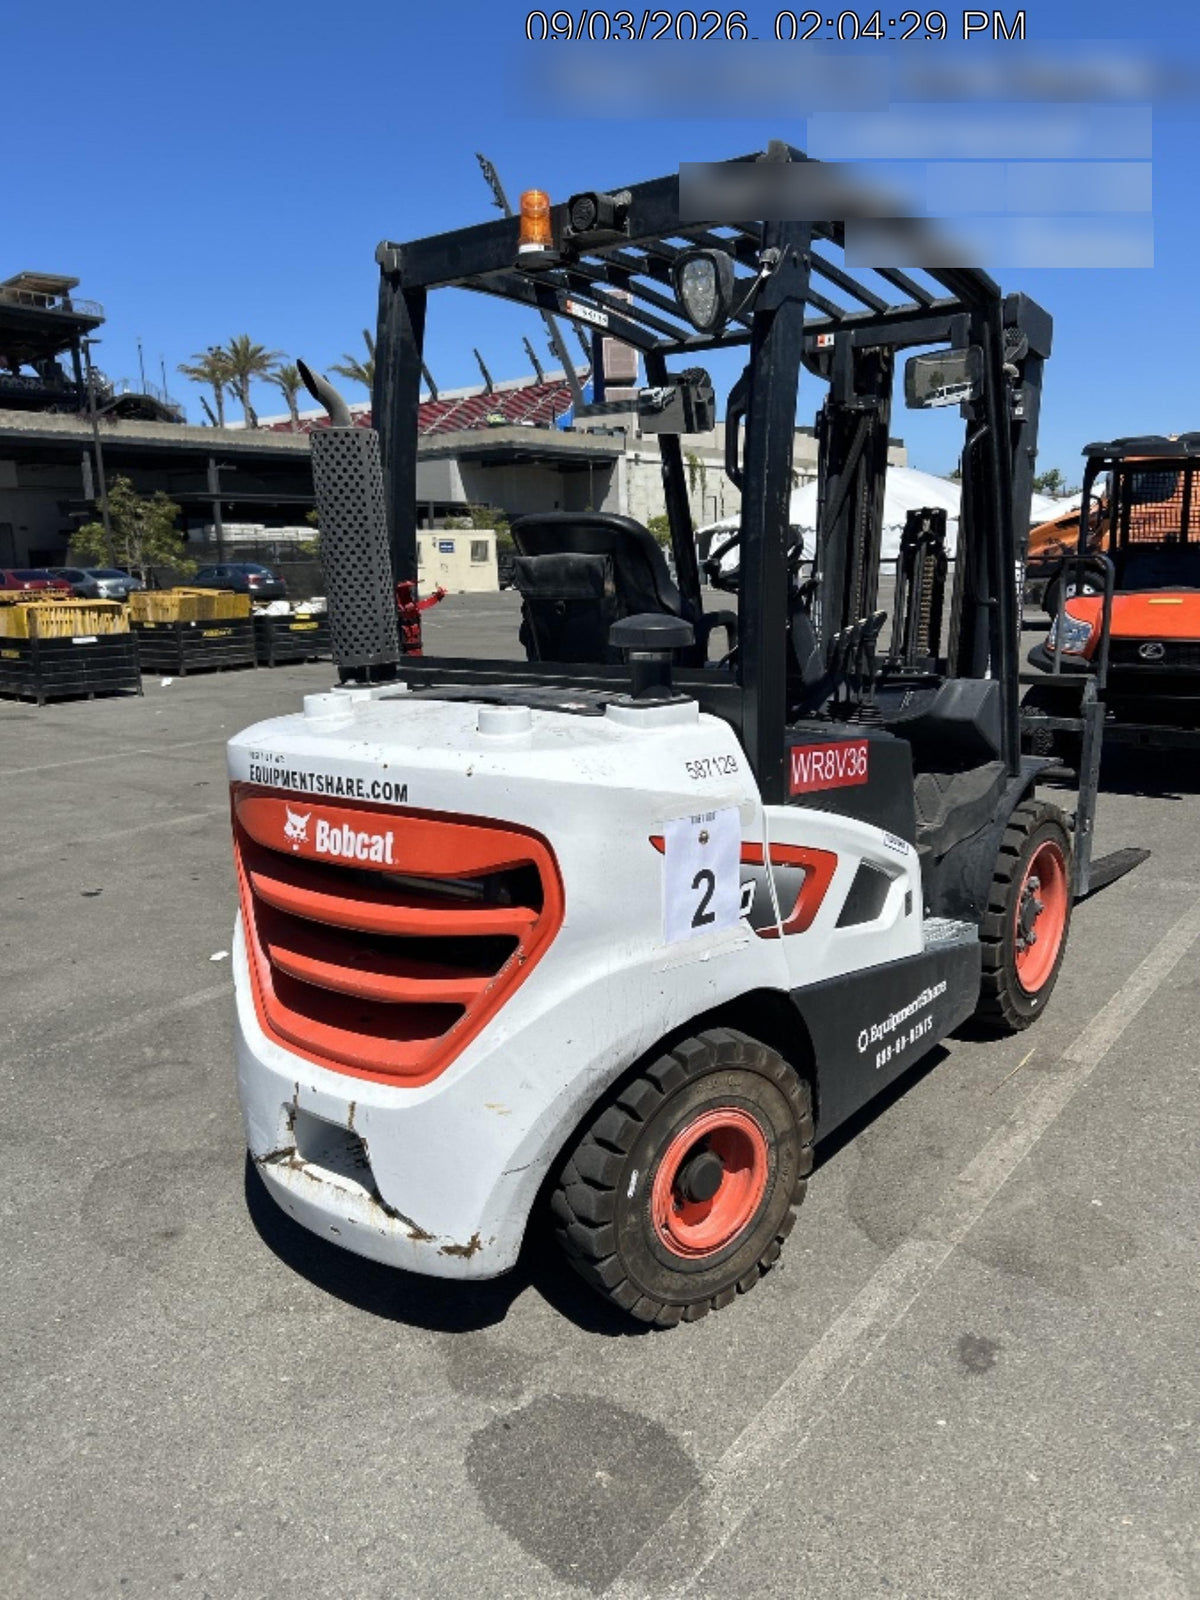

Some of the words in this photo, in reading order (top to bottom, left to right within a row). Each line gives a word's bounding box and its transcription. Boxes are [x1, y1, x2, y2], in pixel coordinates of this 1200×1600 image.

[250, 764, 408, 803] EQUIPMENTSHARE.COM
[685, 755, 739, 779] 587129
[791, 746, 868, 785] WR8V36
[316, 819, 394, 865] Bobcat
[691, 868, 716, 928] 2
